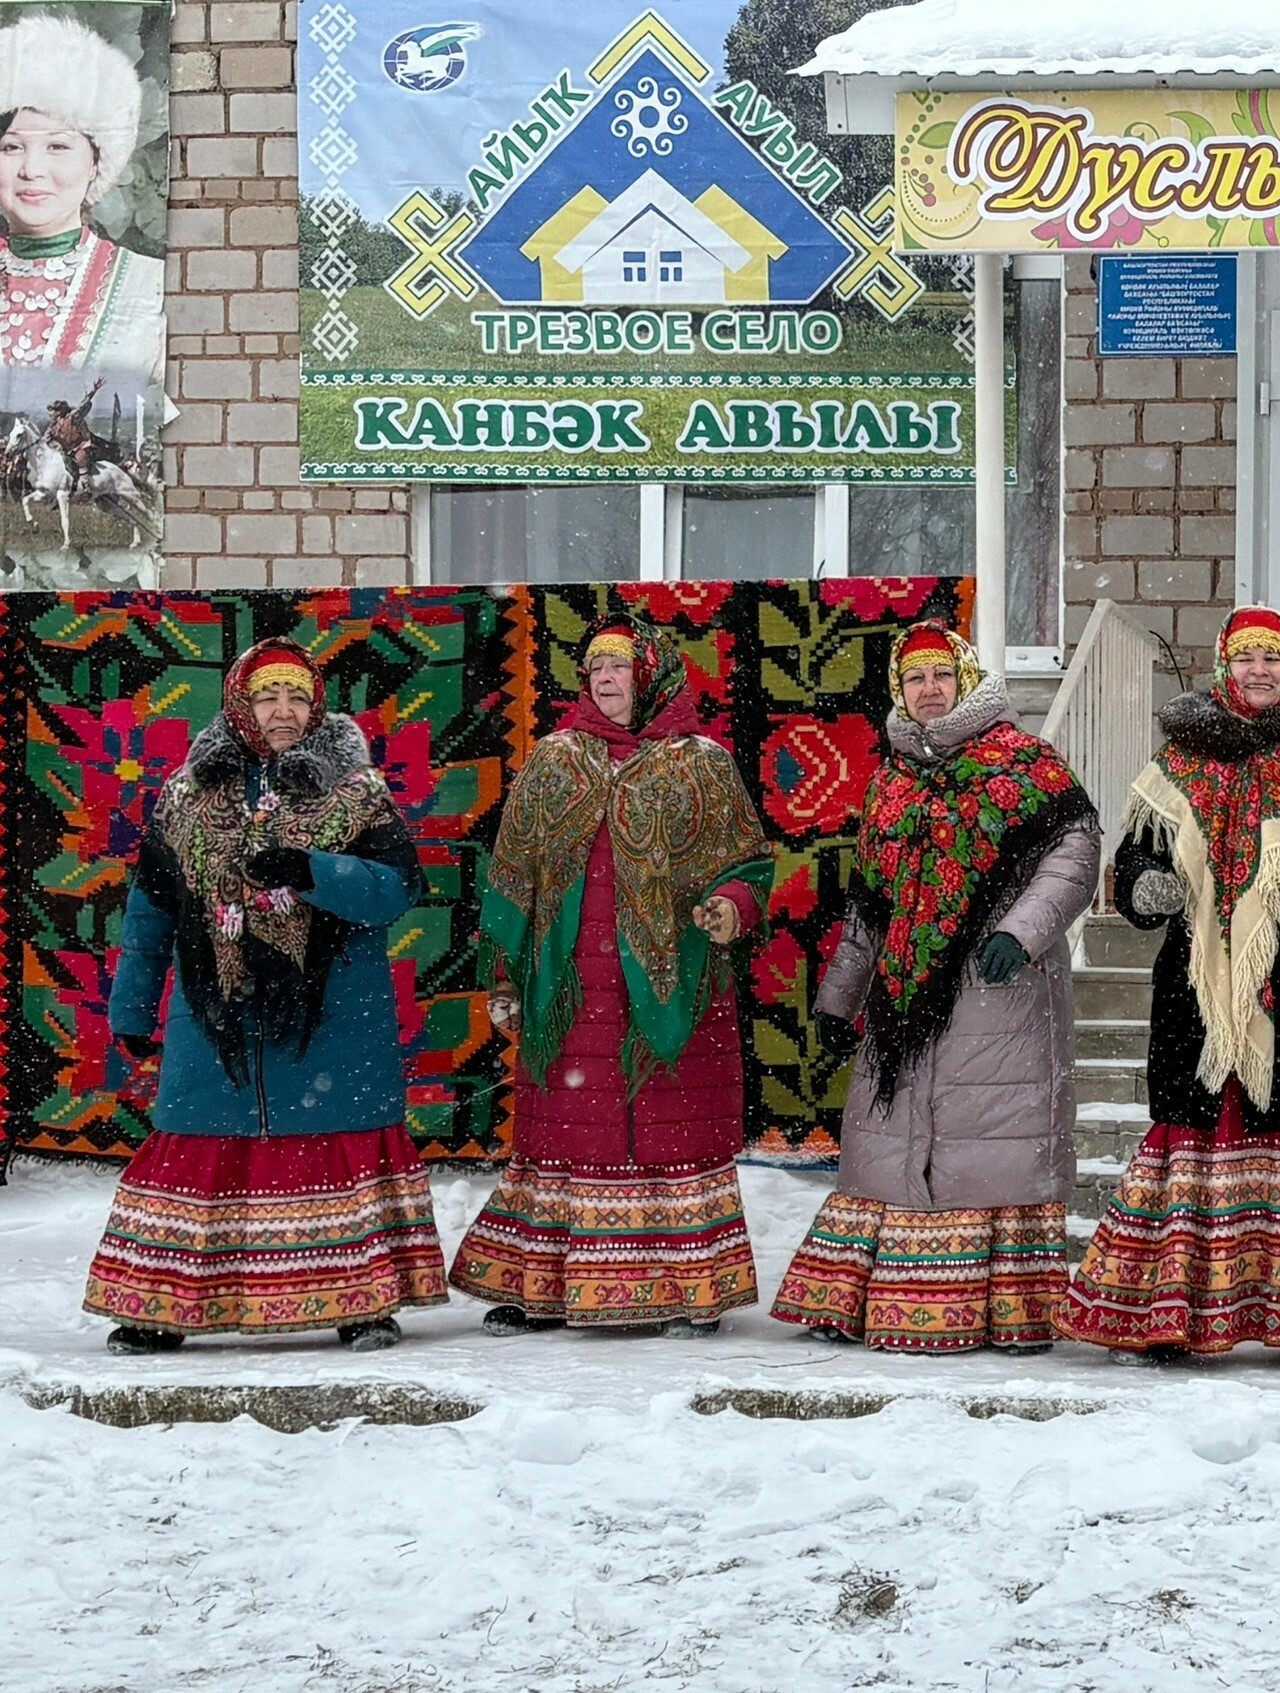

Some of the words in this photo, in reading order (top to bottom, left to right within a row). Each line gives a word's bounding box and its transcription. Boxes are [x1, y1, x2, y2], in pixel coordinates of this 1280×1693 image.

[716, 83, 839, 200] АУЫЛ
[477, 315, 694, 352] ТРЕЗВОЕ
[705, 314, 840, 351] СЕЛО
[357, 403, 645, 450] КАНБӘК
[680, 403, 957, 450] АВЫЛЫ
